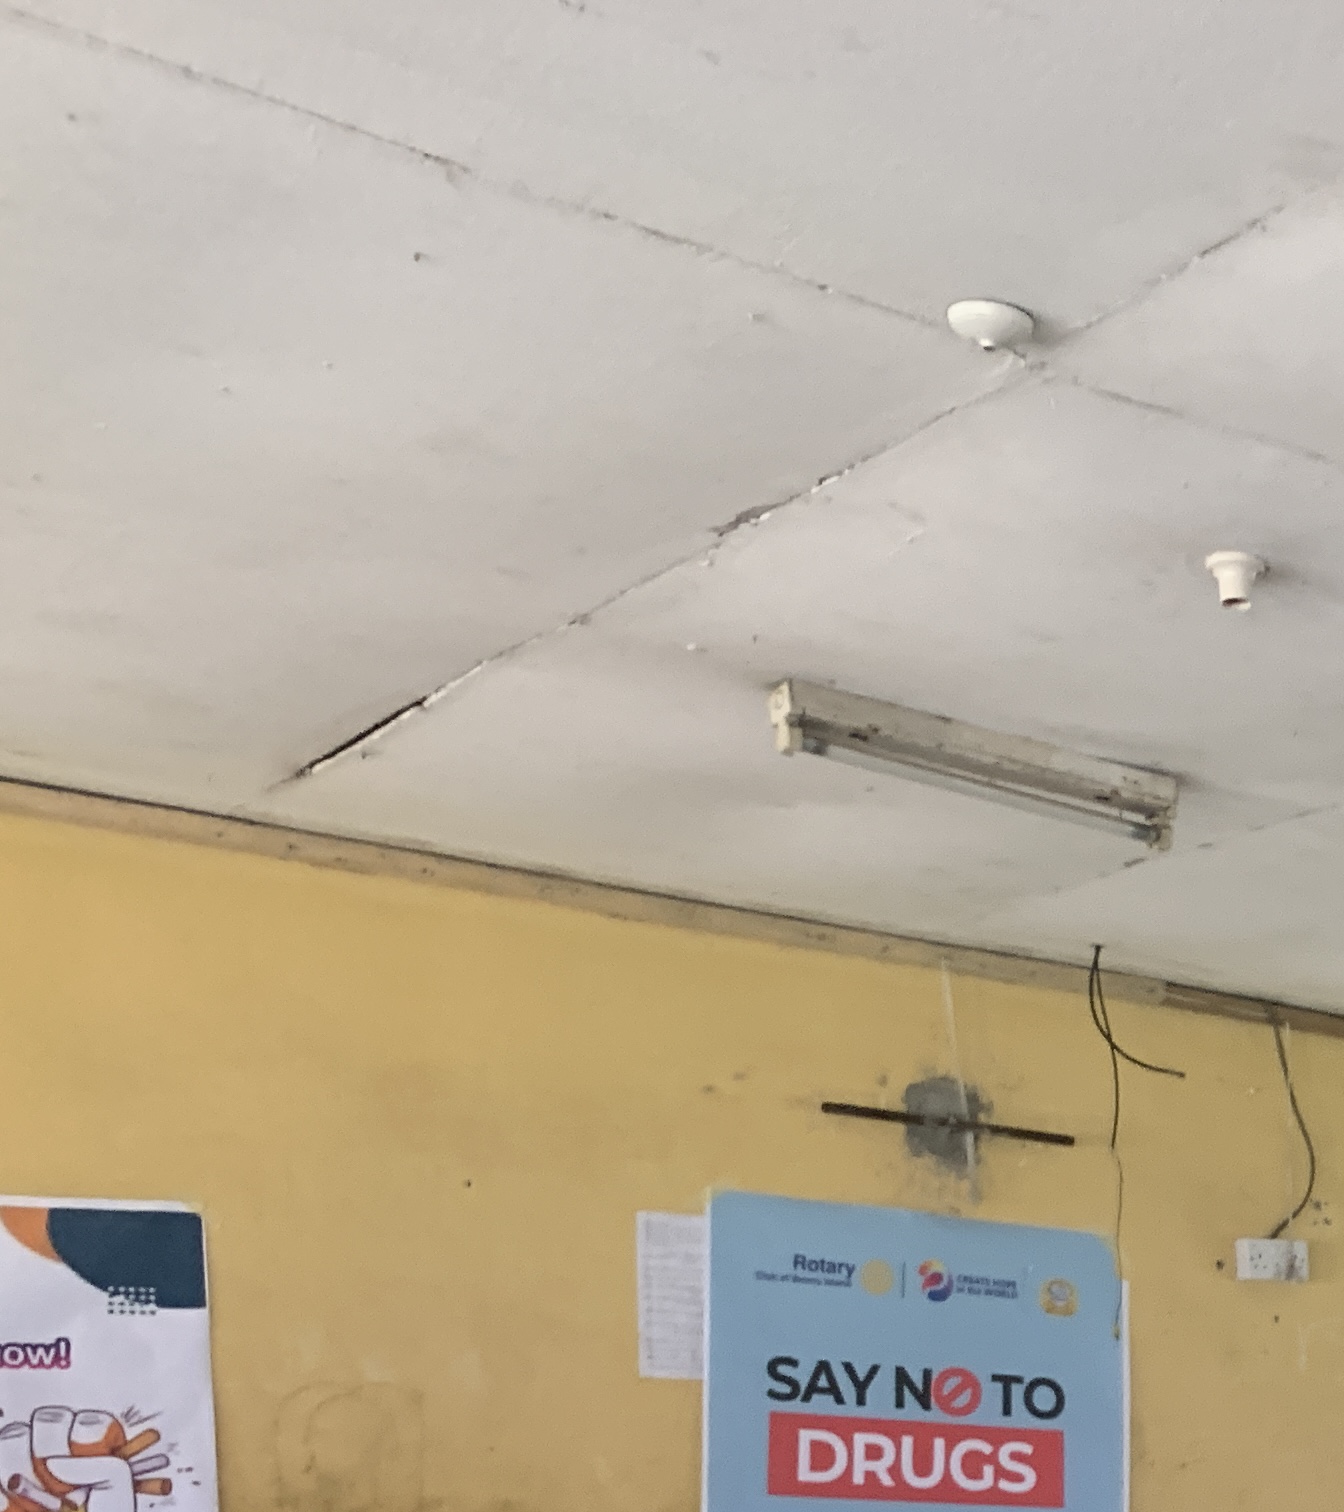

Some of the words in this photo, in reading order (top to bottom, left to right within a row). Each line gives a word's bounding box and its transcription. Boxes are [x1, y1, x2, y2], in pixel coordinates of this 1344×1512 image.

[793, 1253, 856, 1280] Rotary
[0, 1337, 71, 1370] ow!
[766, 1356, 881, 1407] SAY
[991, 1373, 1065, 1420] TO
[797, 1428, 1038, 1494] DRUGS
